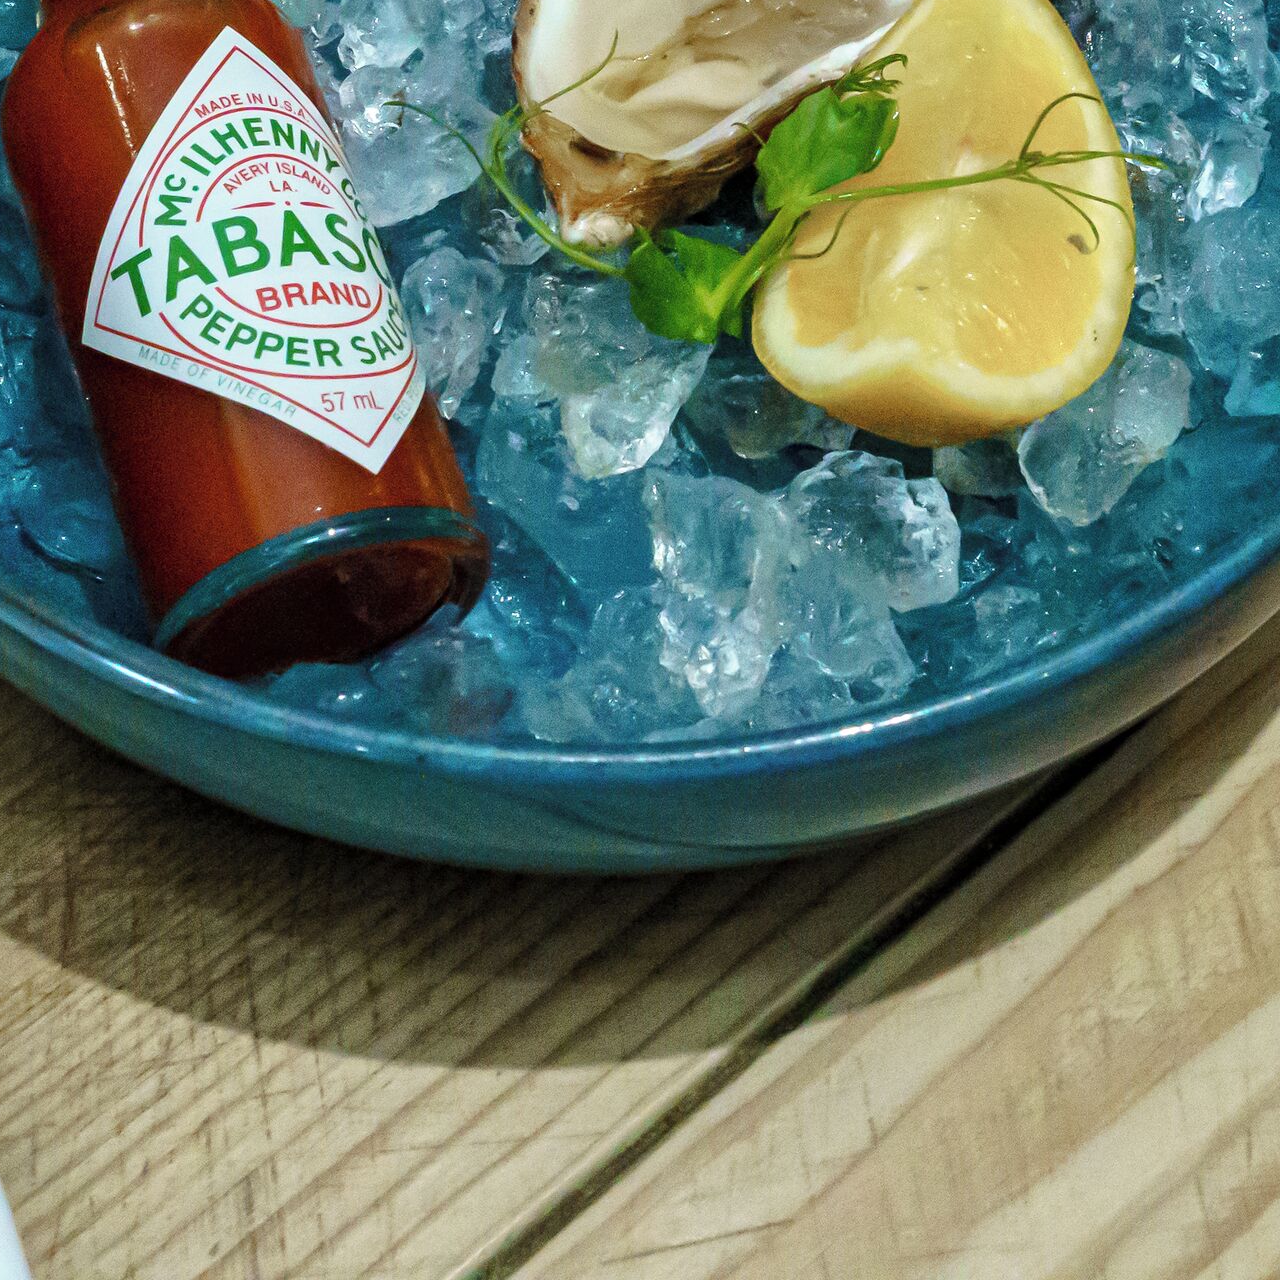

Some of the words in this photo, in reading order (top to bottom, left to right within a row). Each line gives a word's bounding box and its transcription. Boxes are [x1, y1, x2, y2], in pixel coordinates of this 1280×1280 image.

[194, 93, 243, 119] MADE
[247, 92, 264, 105] IN
[268, 94, 310, 122] U.S.A.
[223, 162, 270, 195] AVERY
[276, 161, 331, 196] ISLAND
[269, 180, 298, 193] LA.
[111, 210, 393, 317] TABASC
[256, 281, 372, 312] BRAND
[179, 294, 343, 367] PEPPER
[351, 293, 408, 365] SAUC
[138, 345, 181, 369] MADE
[187, 363, 213, 380] OF
[217, 373, 297, 418] VINEGAR
[320, 391, 345, 413] 57
[353, 390, 384, 410] mL
